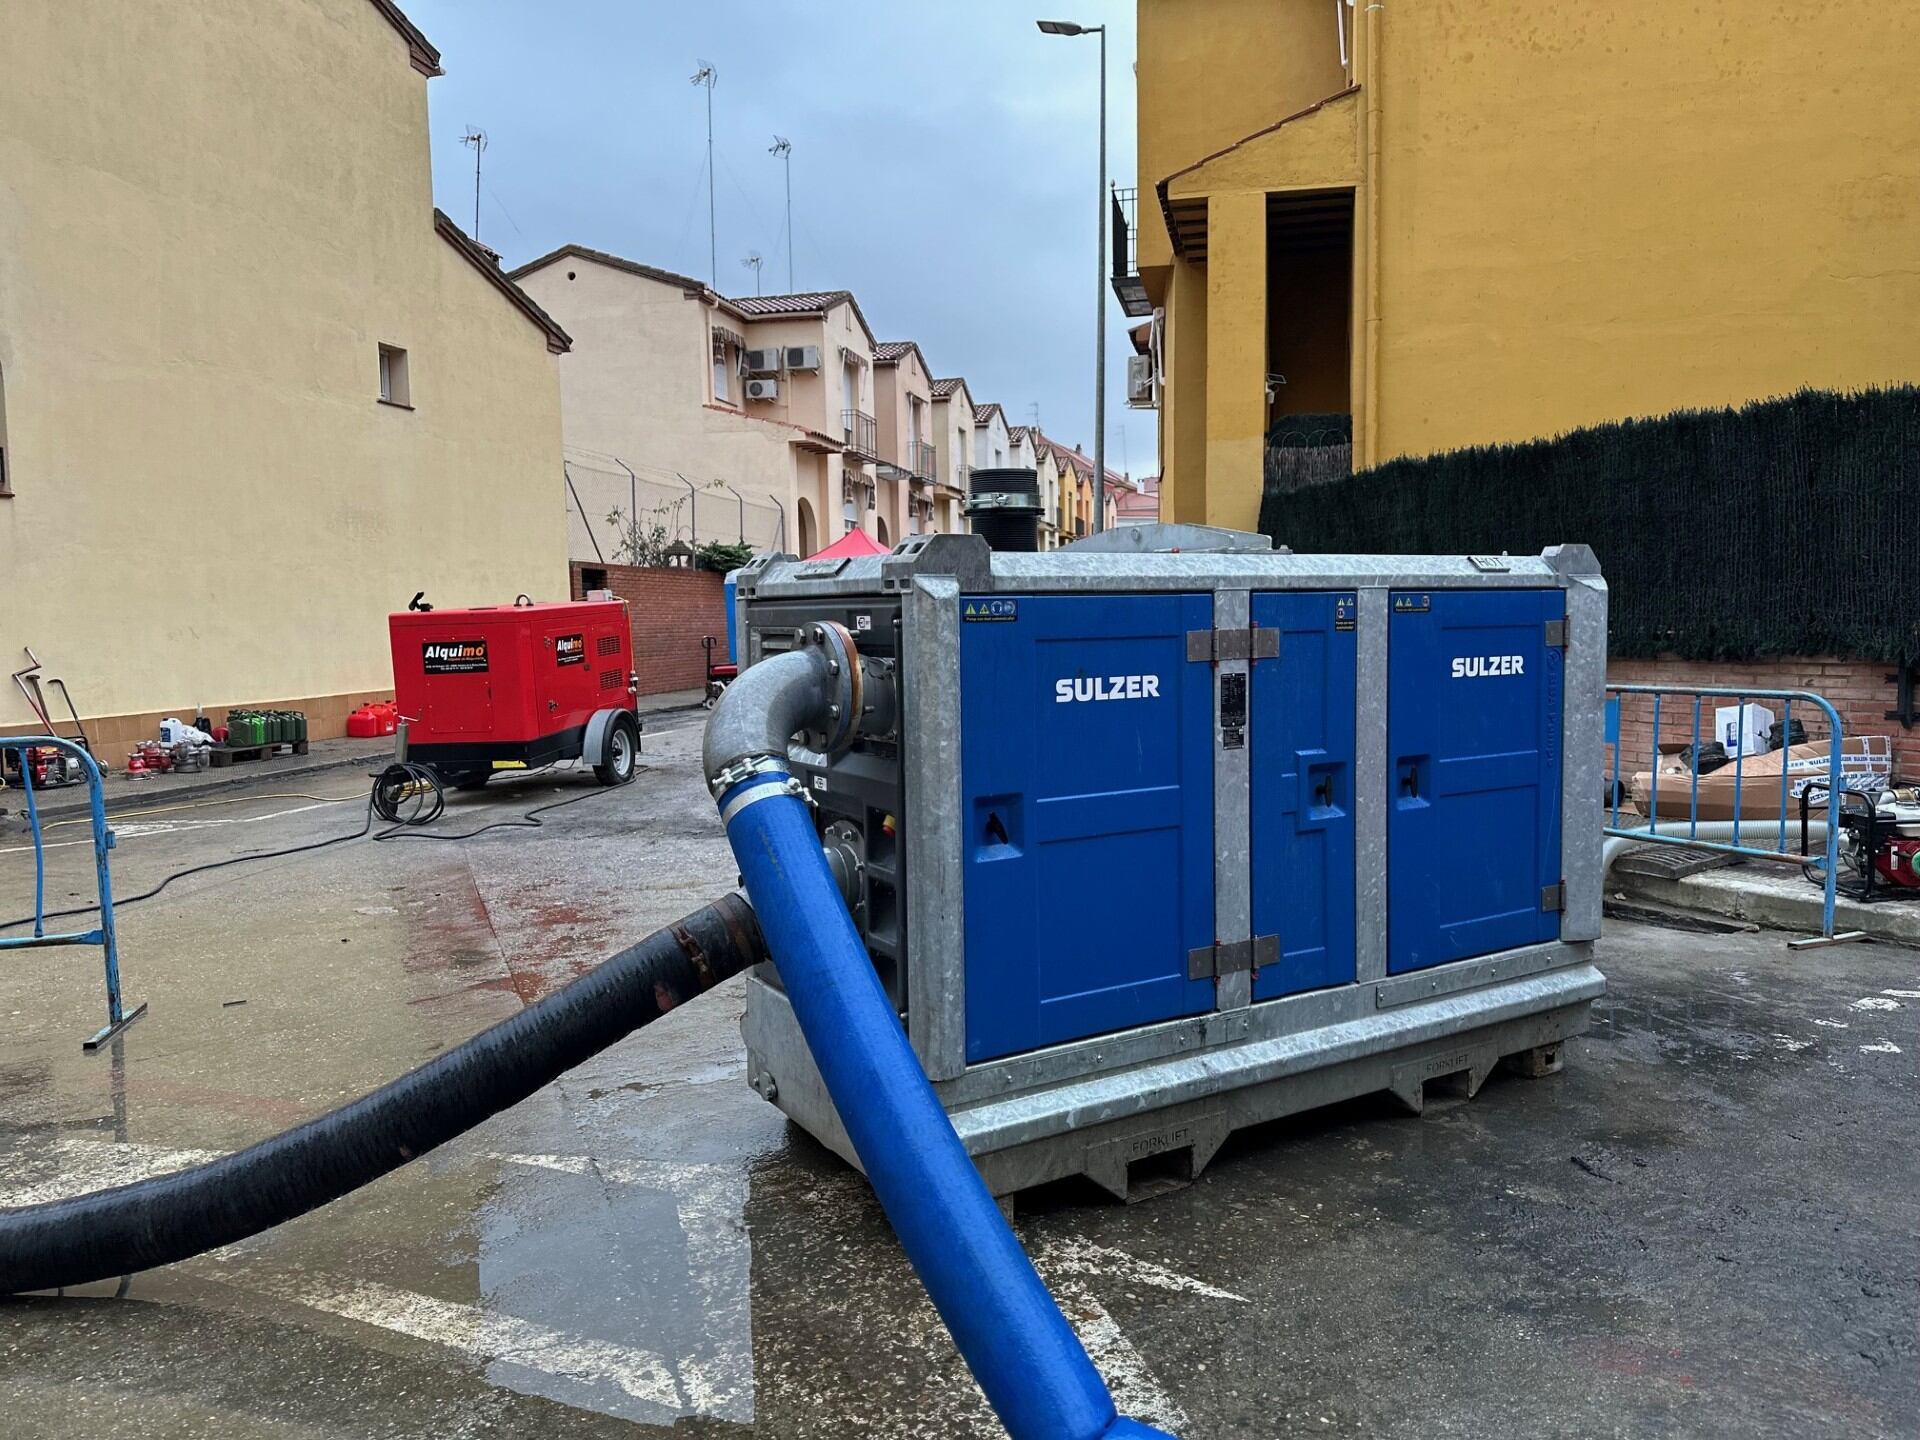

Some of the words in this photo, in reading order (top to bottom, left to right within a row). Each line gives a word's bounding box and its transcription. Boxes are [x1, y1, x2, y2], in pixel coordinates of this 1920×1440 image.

[1474, 557, 1504, 567] HOT
[425, 645, 484, 660] Alquimo
[556, 638, 582, 653] Alquimo
[1452, 655, 1524, 678] SULZER
[1056, 675, 1160, 703] SULZER
[1426, 1054, 1469, 1073] FORKLIFT
[1131, 1128, 1189, 1153] FORKLIFT
